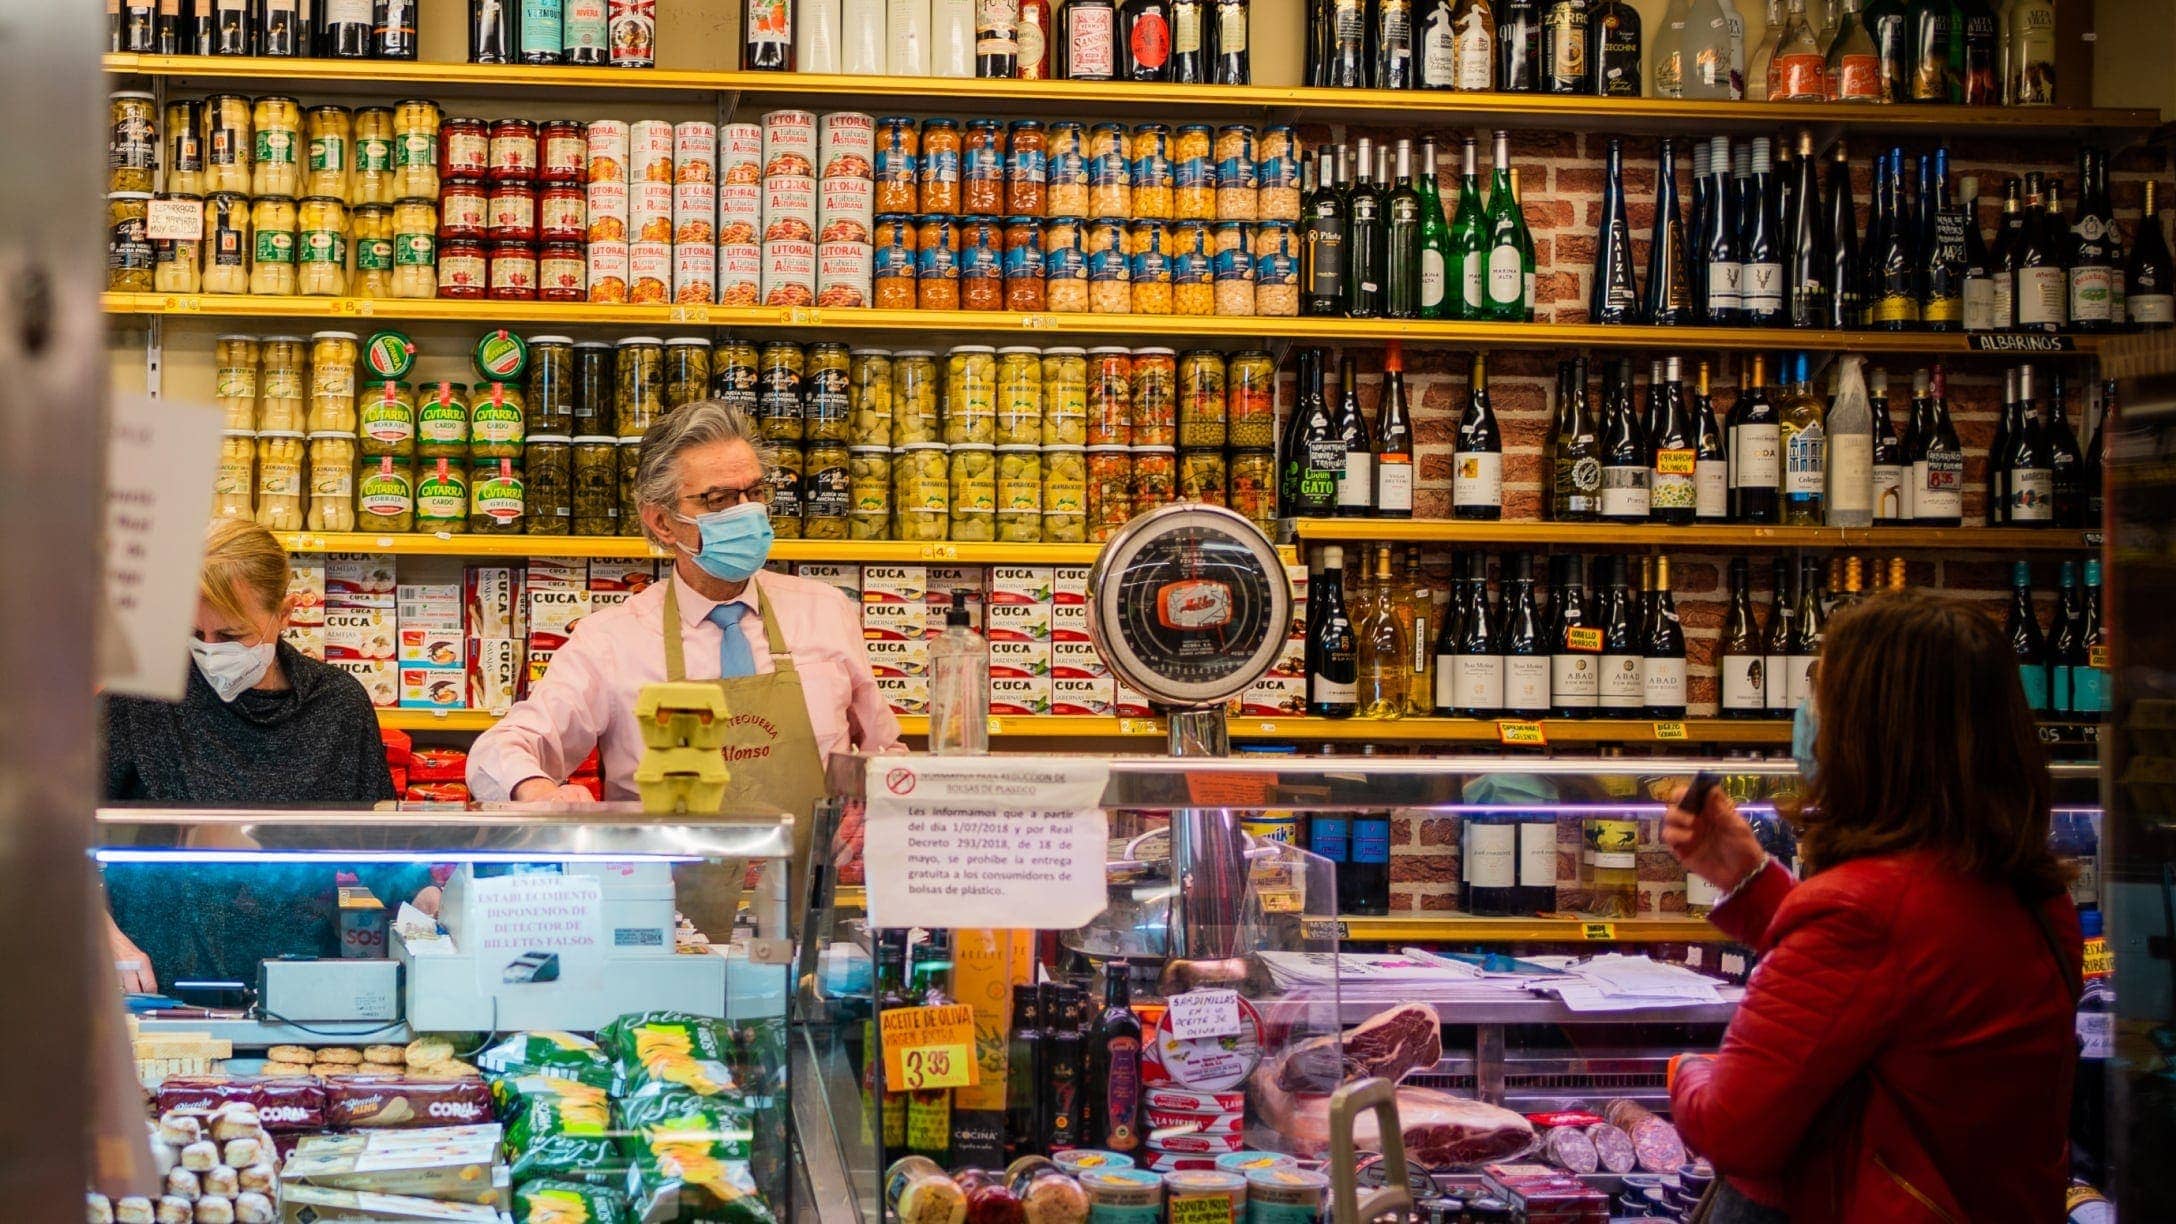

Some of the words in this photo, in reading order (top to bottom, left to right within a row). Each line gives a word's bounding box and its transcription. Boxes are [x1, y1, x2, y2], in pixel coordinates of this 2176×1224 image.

[1544, 12, 1588, 25] ZARRO
[768, 115, 811, 125] LITORAL
[829, 117, 872, 128] LITORAL
[592, 246, 626, 255] LITORAL
[632, 248, 664, 256] LITORAL
[772, 245, 813, 256] LITORAL
[821, 246, 862, 256] LITORAL
[1613, 230, 1624, 283] YAIZA
[1301, 481, 1334, 494] GATO
[800, 566, 840, 576] CUCA
[866, 569, 906, 578] CUCA
[996, 570, 1034, 579] CUCA
[498, 570, 508, 614] CUCA
[534, 593, 578, 604] CUCA
[866, 606, 906, 616] CUCA
[992, 607, 1030, 616] CUCA
[326, 616, 370, 627] CUCA
[867, 642, 906, 652] CUCA
[992, 644, 1030, 654] CUCA
[1055, 644, 1094, 654] CUCA
[500, 641, 510, 684] CUCA
[1568, 672, 1594, 680] ABAD
[878, 680, 906, 689] UCA
[993, 681, 1032, 690] CUCA
[1055, 681, 1094, 690] CUCA
[946, 784, 980, 794] BOLSAS
[982, 785, 994, 794] DE
[908, 808, 926, 816] Les
[932, 807, 996, 818] informamos
[1004, 810, 1024, 820] que
[1044, 810, 1074, 820] partir
[908, 822, 925, 832] del
[952, 822, 1009, 834] 1/07/2018
[1014, 825, 1021, 834] y
[1026, 825, 1045, 835] por
[1050, 824, 1073, 834] Real
[908, 838, 950, 848] Decreto
[1018, 840, 1032, 850] de
[1039, 840, 1052, 850] 18
[1059, 840, 1072, 850] de
[908, 854, 940, 866] mayo,
[948, 855, 960, 864] se
[1014, 856, 1025, 864] la
[1031, 857, 1072, 866] entrega
[908, 869, 950, 880] gratuita
[954, 872, 960, 880] a
[963, 869, 978, 880] los
[982, 870, 1055, 880] consumidores
[1058, 872, 1072, 881] de
[908, 884, 942, 894] bolsas
[945, 885, 958, 894] de
[487, 906, 569, 918] DISPONEMOS
[572, 905, 588, 916] DE
[347, 928, 382, 946] SOS
[546, 936, 595, 946] FALSOS
[1173, 994, 1236, 1008] SARDINILLAS
[883, 1011, 921, 1030] ACEITE
[924, 1010, 937, 1028] DE
[940, 1006, 972, 1026] OLIVA
[955, 1131, 996, 1140] COCINA
